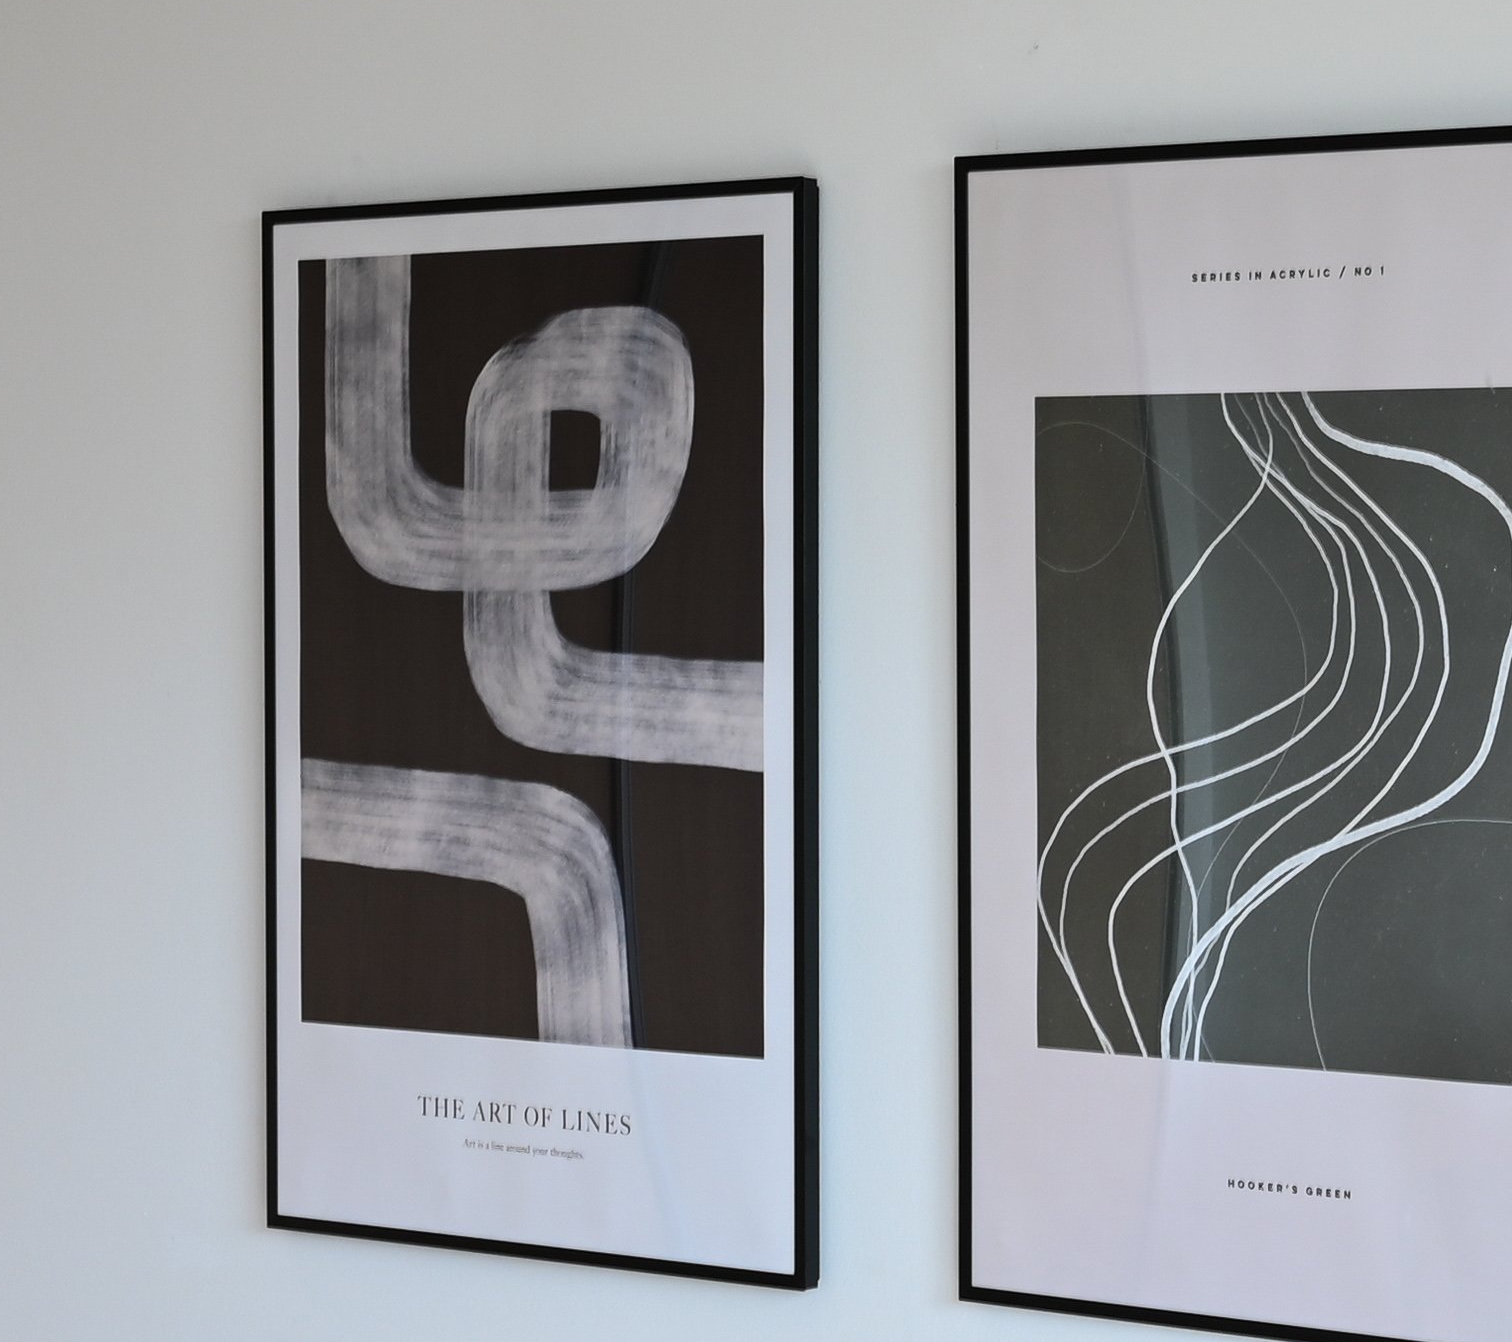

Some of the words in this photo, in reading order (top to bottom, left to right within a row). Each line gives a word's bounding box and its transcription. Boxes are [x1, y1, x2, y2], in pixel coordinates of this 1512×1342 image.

[1191, 271, 1241, 284] SERIES
[1249, 271, 1263, 281] IN
[1269, 268, 1331, 280] ACRYLIC
[1354, 266, 1373, 277] NO
[417, 1095, 465, 1120] THE
[473, 1100, 517, 1125] ART
[524, 1105, 553, 1128] OF
[561, 1109, 632, 1136] LINES
[463, 1138, 477, 1149] Art
[477, 1139, 484, 1149] is
[1227, 1178, 1298, 1195] HOOKER'S
[1305, 1186, 1352, 1201] GREEN
